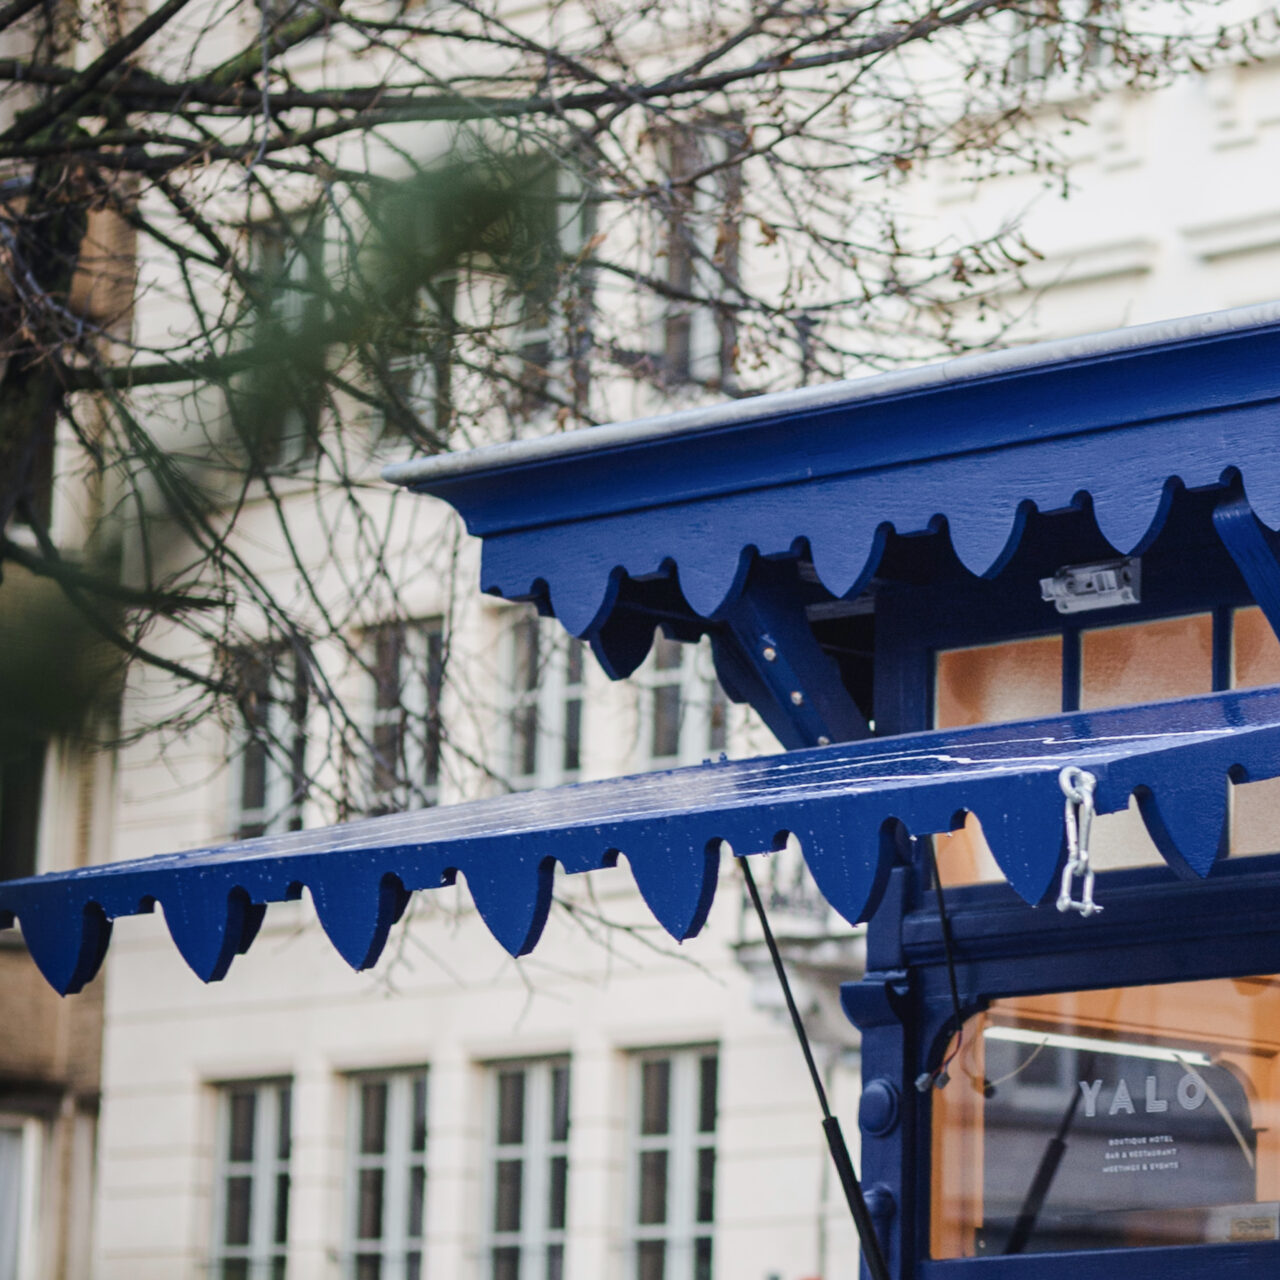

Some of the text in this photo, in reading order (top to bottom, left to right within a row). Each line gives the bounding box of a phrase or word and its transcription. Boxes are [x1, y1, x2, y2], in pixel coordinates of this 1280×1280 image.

[1079, 1072, 1207, 1117] YALO
[1108, 1135, 1174, 1146] BOUTIQUE HOTEL
[1105, 1151, 1120, 1159] BAR
[1129, 1148, 1177, 1157] RESTAURANT
[1102, 1164, 1140, 1173] MEETINGS
[1149, 1161, 1179, 1170] EVENTS
